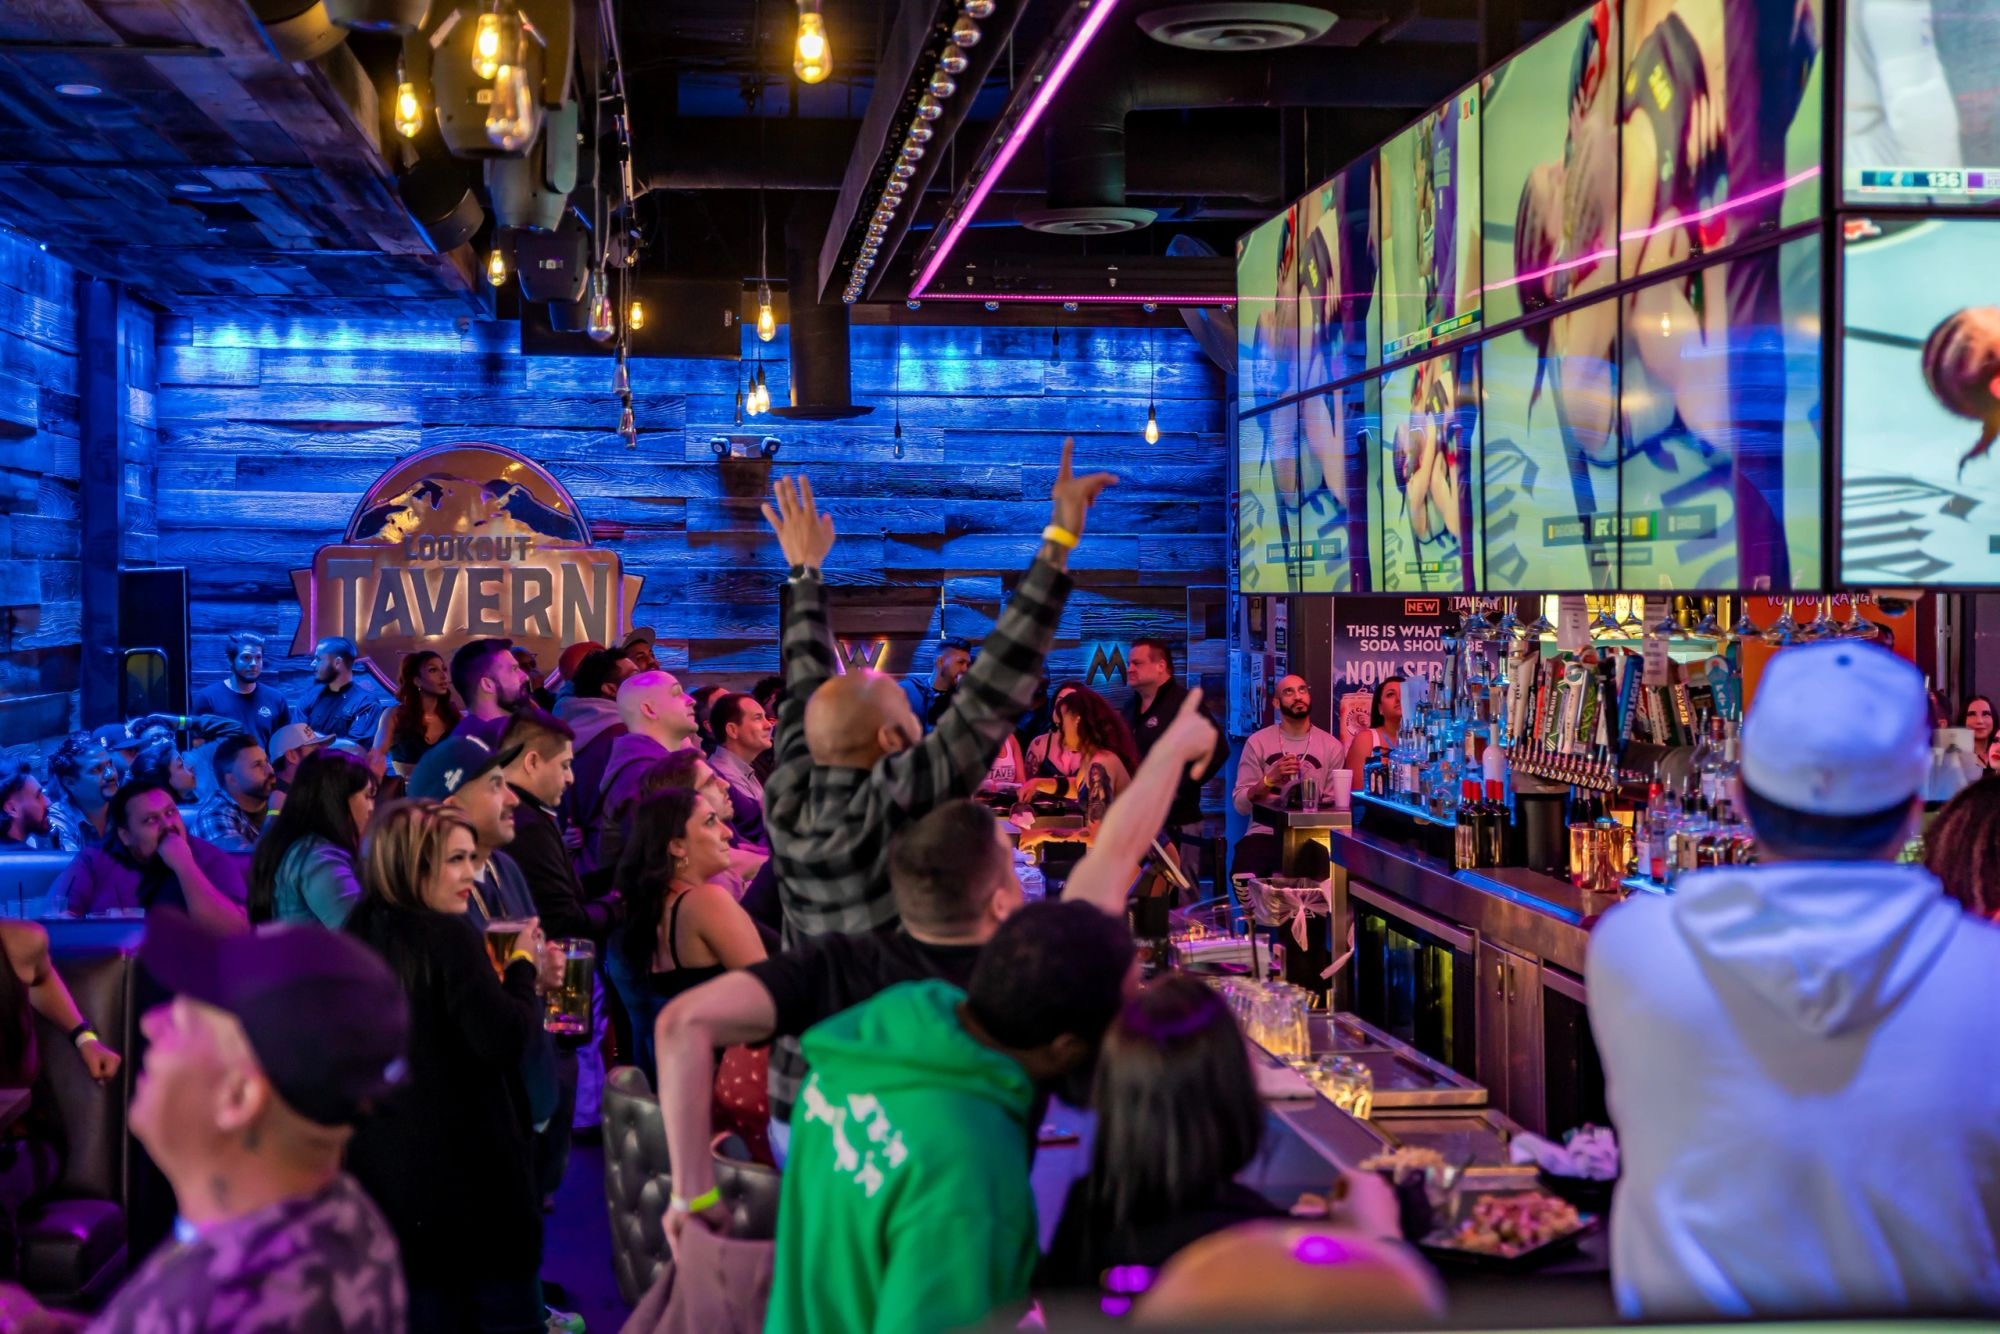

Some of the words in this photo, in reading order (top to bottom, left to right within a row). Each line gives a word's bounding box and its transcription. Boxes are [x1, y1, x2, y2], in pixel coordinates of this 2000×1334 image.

[404, 535, 531, 561] LOOKOUT
[327, 558, 610, 649] TAVERN
[1408, 602, 1436, 612] NEW
[1768, 593, 1825, 606] VODOO
[1832, 593, 1879, 606] RANGE
[1346, 625, 1380, 637] THIS
[1383, 625, 1396, 637] IS
[1399, 625, 1443, 637] WHAT
[1360, 640, 1400, 652] SODA
[1404, 640, 1444, 652] SHOU
[1085, 643, 1128, 685] M
[1345, 661, 1395, 685] NOW
[1628, 671, 1642, 710] LIGHT
